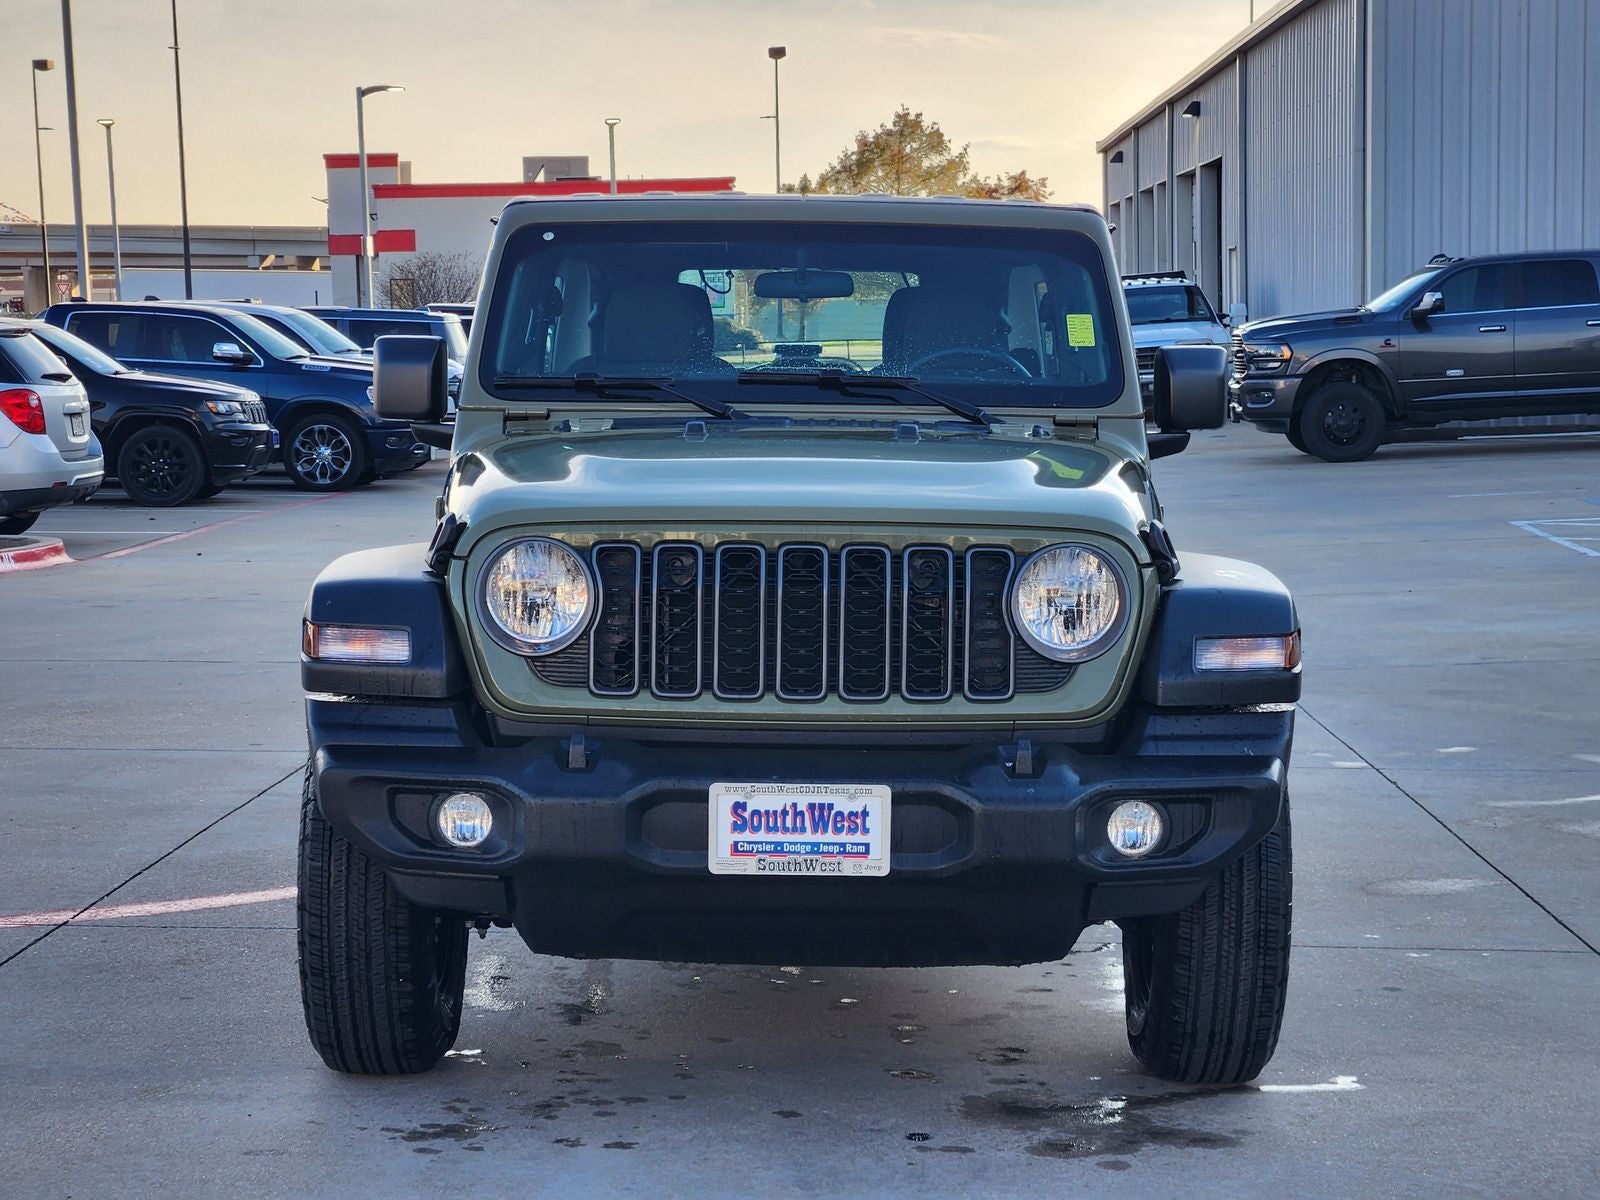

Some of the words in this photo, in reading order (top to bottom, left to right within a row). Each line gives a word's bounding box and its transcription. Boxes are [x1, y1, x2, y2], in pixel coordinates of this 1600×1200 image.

[730, 800, 870, 835] SouthWest
[737, 842, 775, 853] Chrysler
[783, 843, 811, 854] Dodge
[819, 843, 839, 854] Jeep
[846, 844, 865, 853] Ram
[757, 858, 842, 872] SouthWest
